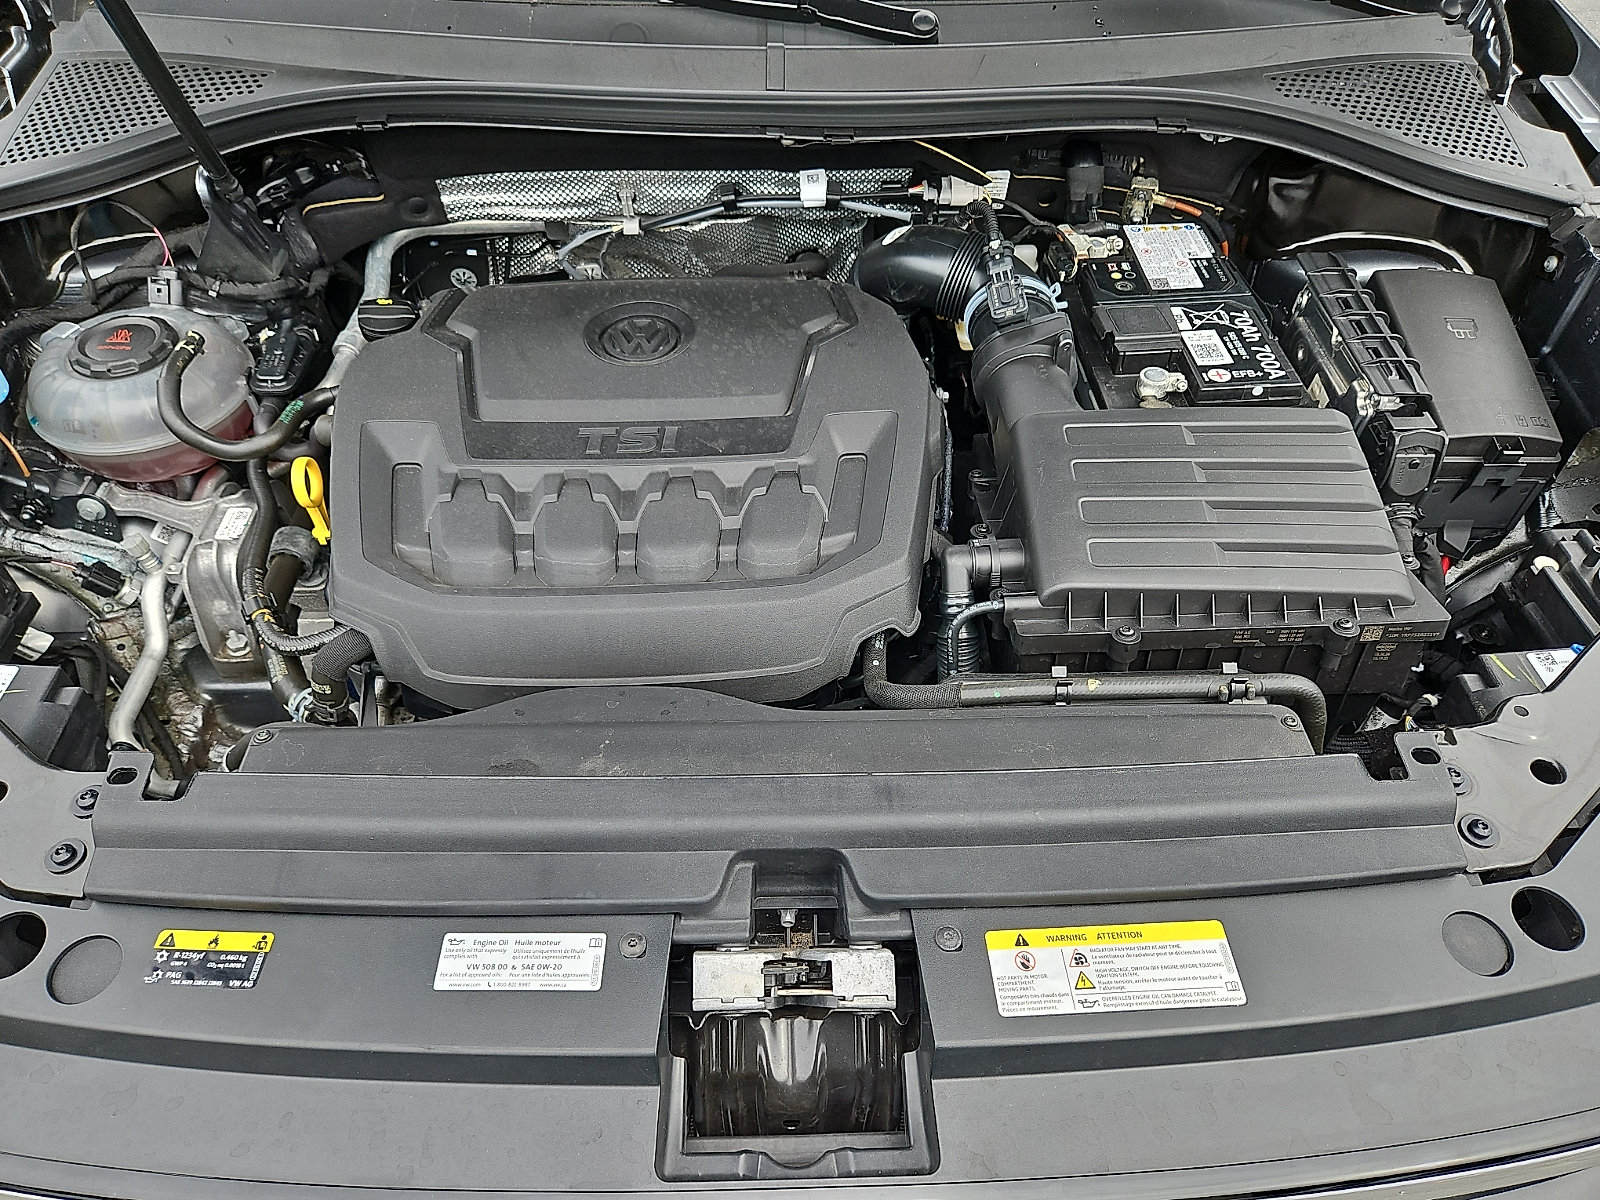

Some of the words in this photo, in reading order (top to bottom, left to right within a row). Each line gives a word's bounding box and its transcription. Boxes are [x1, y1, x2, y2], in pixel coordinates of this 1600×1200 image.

[1230, 310, 1262, 342] 70Ah
[1250, 344, 1286, 380] 700A
[1232, 370, 1263, 378] EFB+
[578, 426, 681, 454] TSI
[1046, 934, 1087, 942] WARNING
[1096, 931, 1142, 940] ATTENTION
[173, 952, 206, 961] R-1234yf
